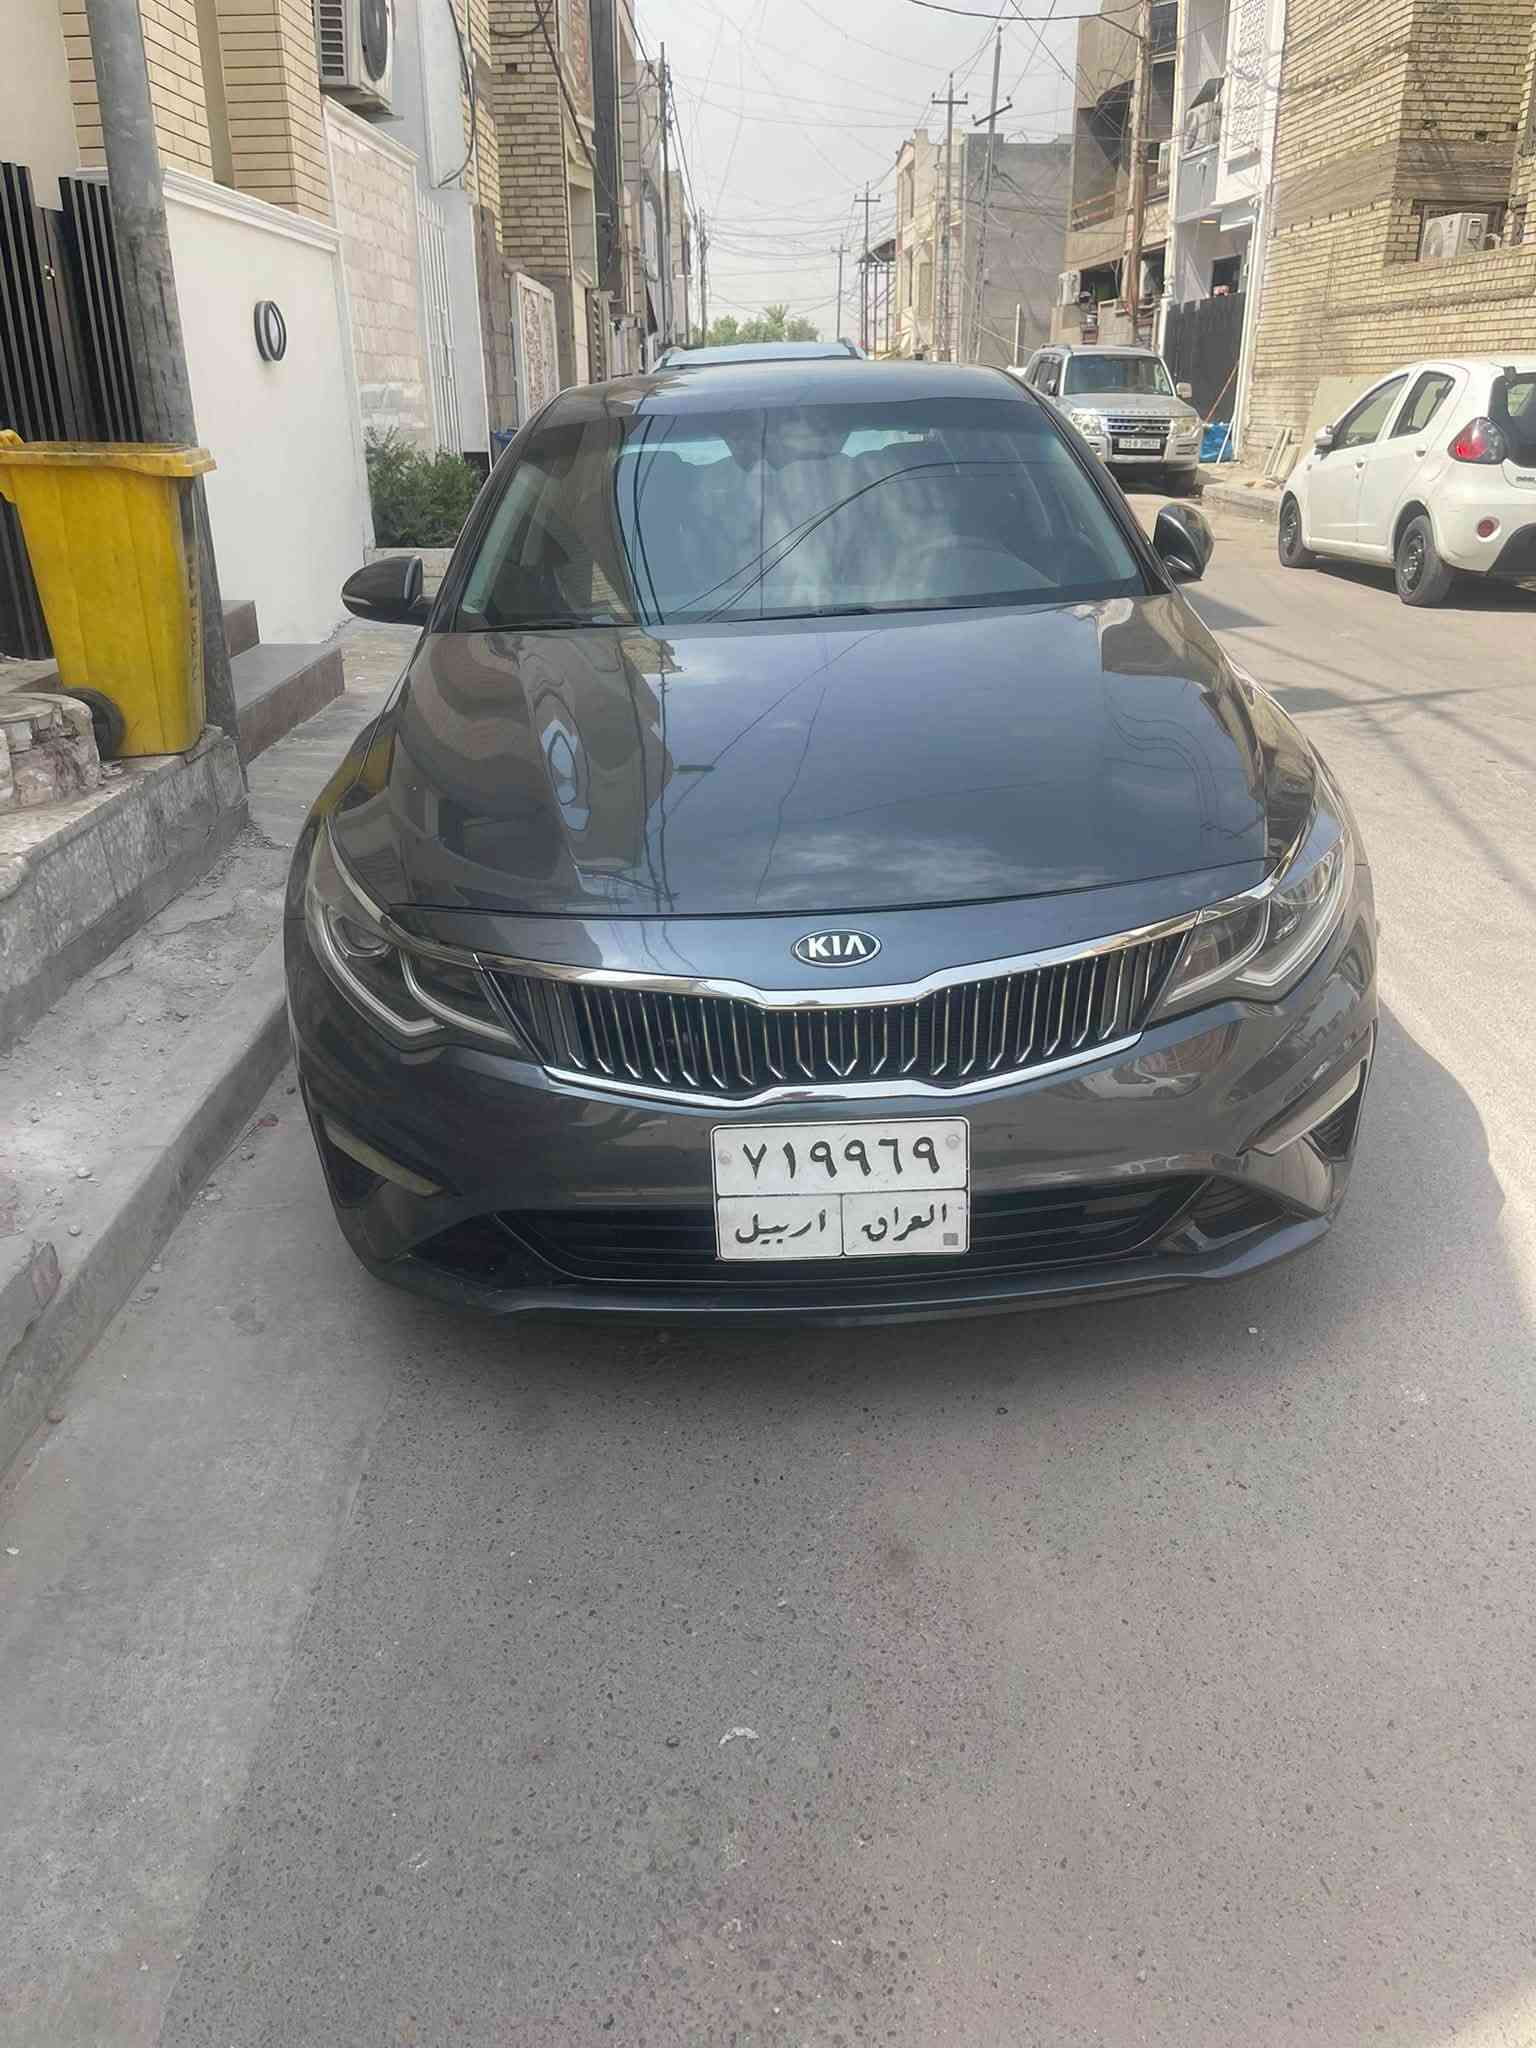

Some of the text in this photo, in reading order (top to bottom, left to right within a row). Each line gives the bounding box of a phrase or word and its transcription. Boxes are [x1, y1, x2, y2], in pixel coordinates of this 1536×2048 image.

[808, 934, 867, 958] KIA
[742, 1136, 940, 1180] ٧١٩٩٦٩
[735, 1208, 826, 1244] اربيل
[860, 1203, 947, 1242] العراق
